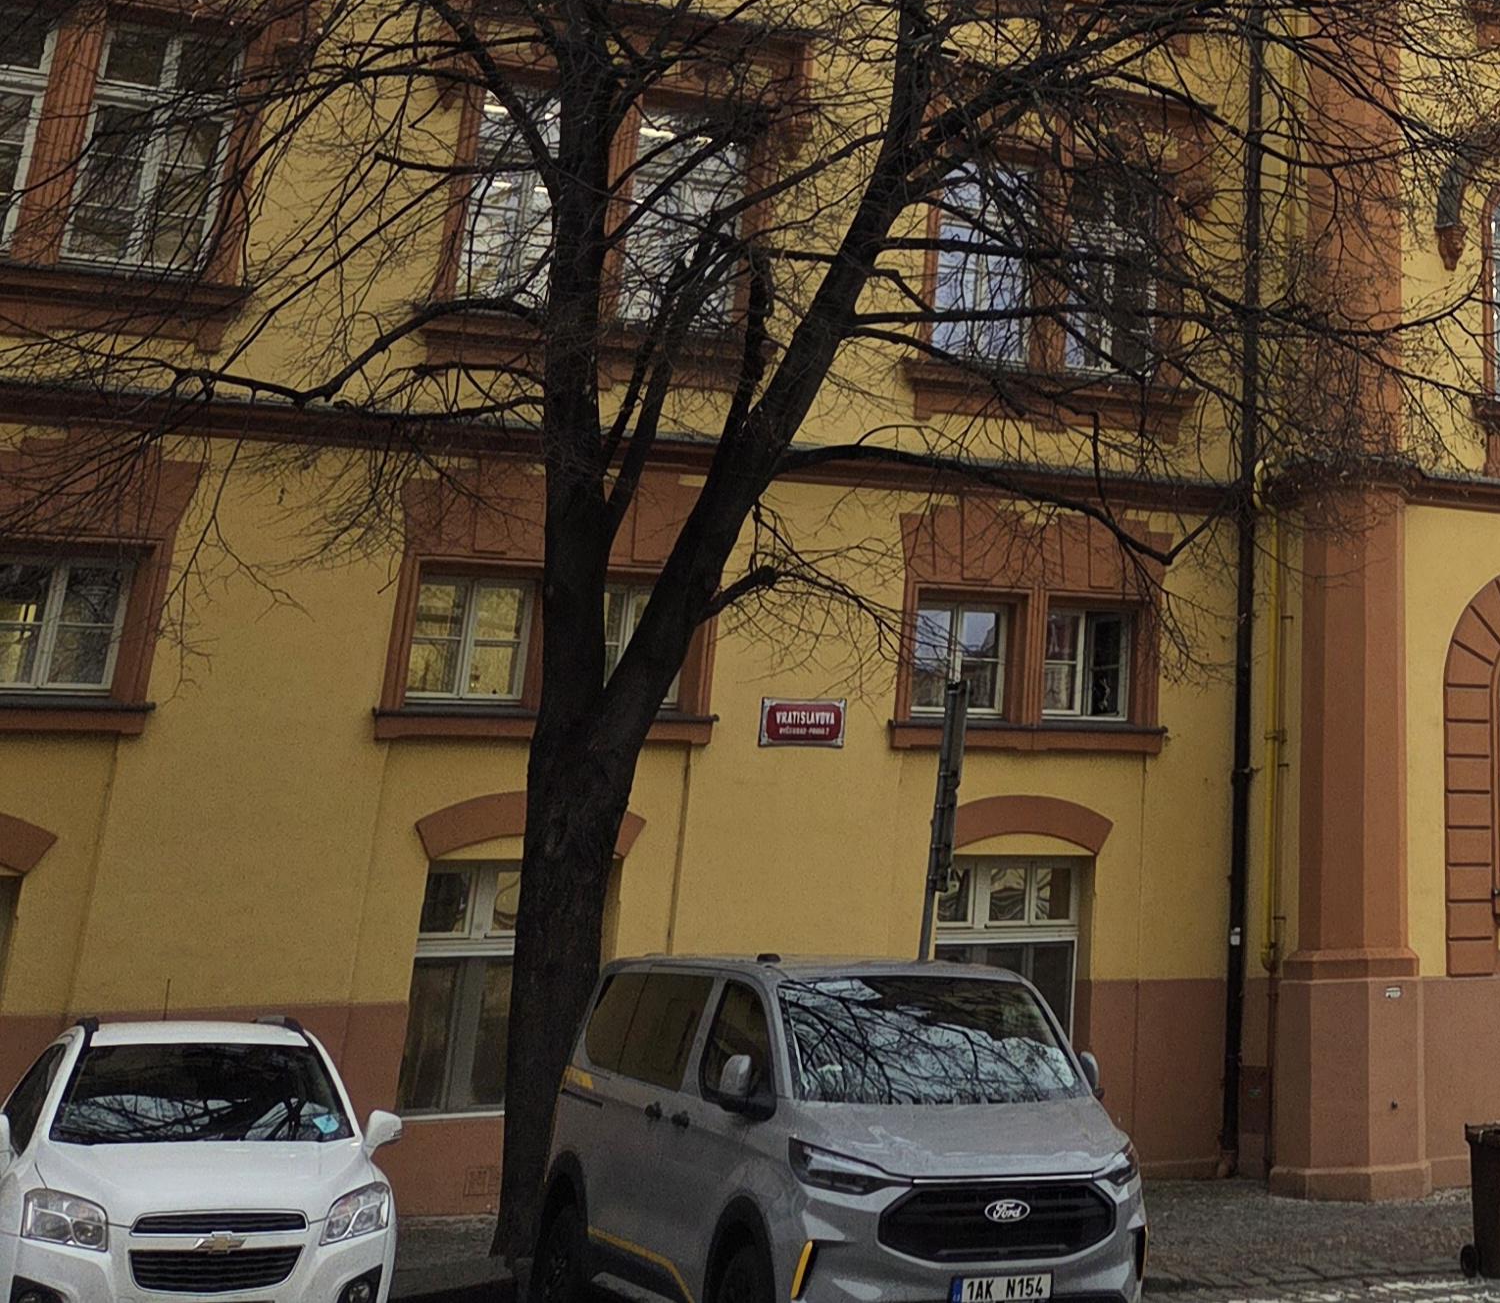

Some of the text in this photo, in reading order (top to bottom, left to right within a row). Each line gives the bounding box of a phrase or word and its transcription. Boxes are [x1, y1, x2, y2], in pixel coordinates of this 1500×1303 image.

[775, 711, 835, 725] VRATISLAVOVA
[993, 1202, 1022, 1219] Ford
[967, 1277, 1043, 1301] 1AK N154
